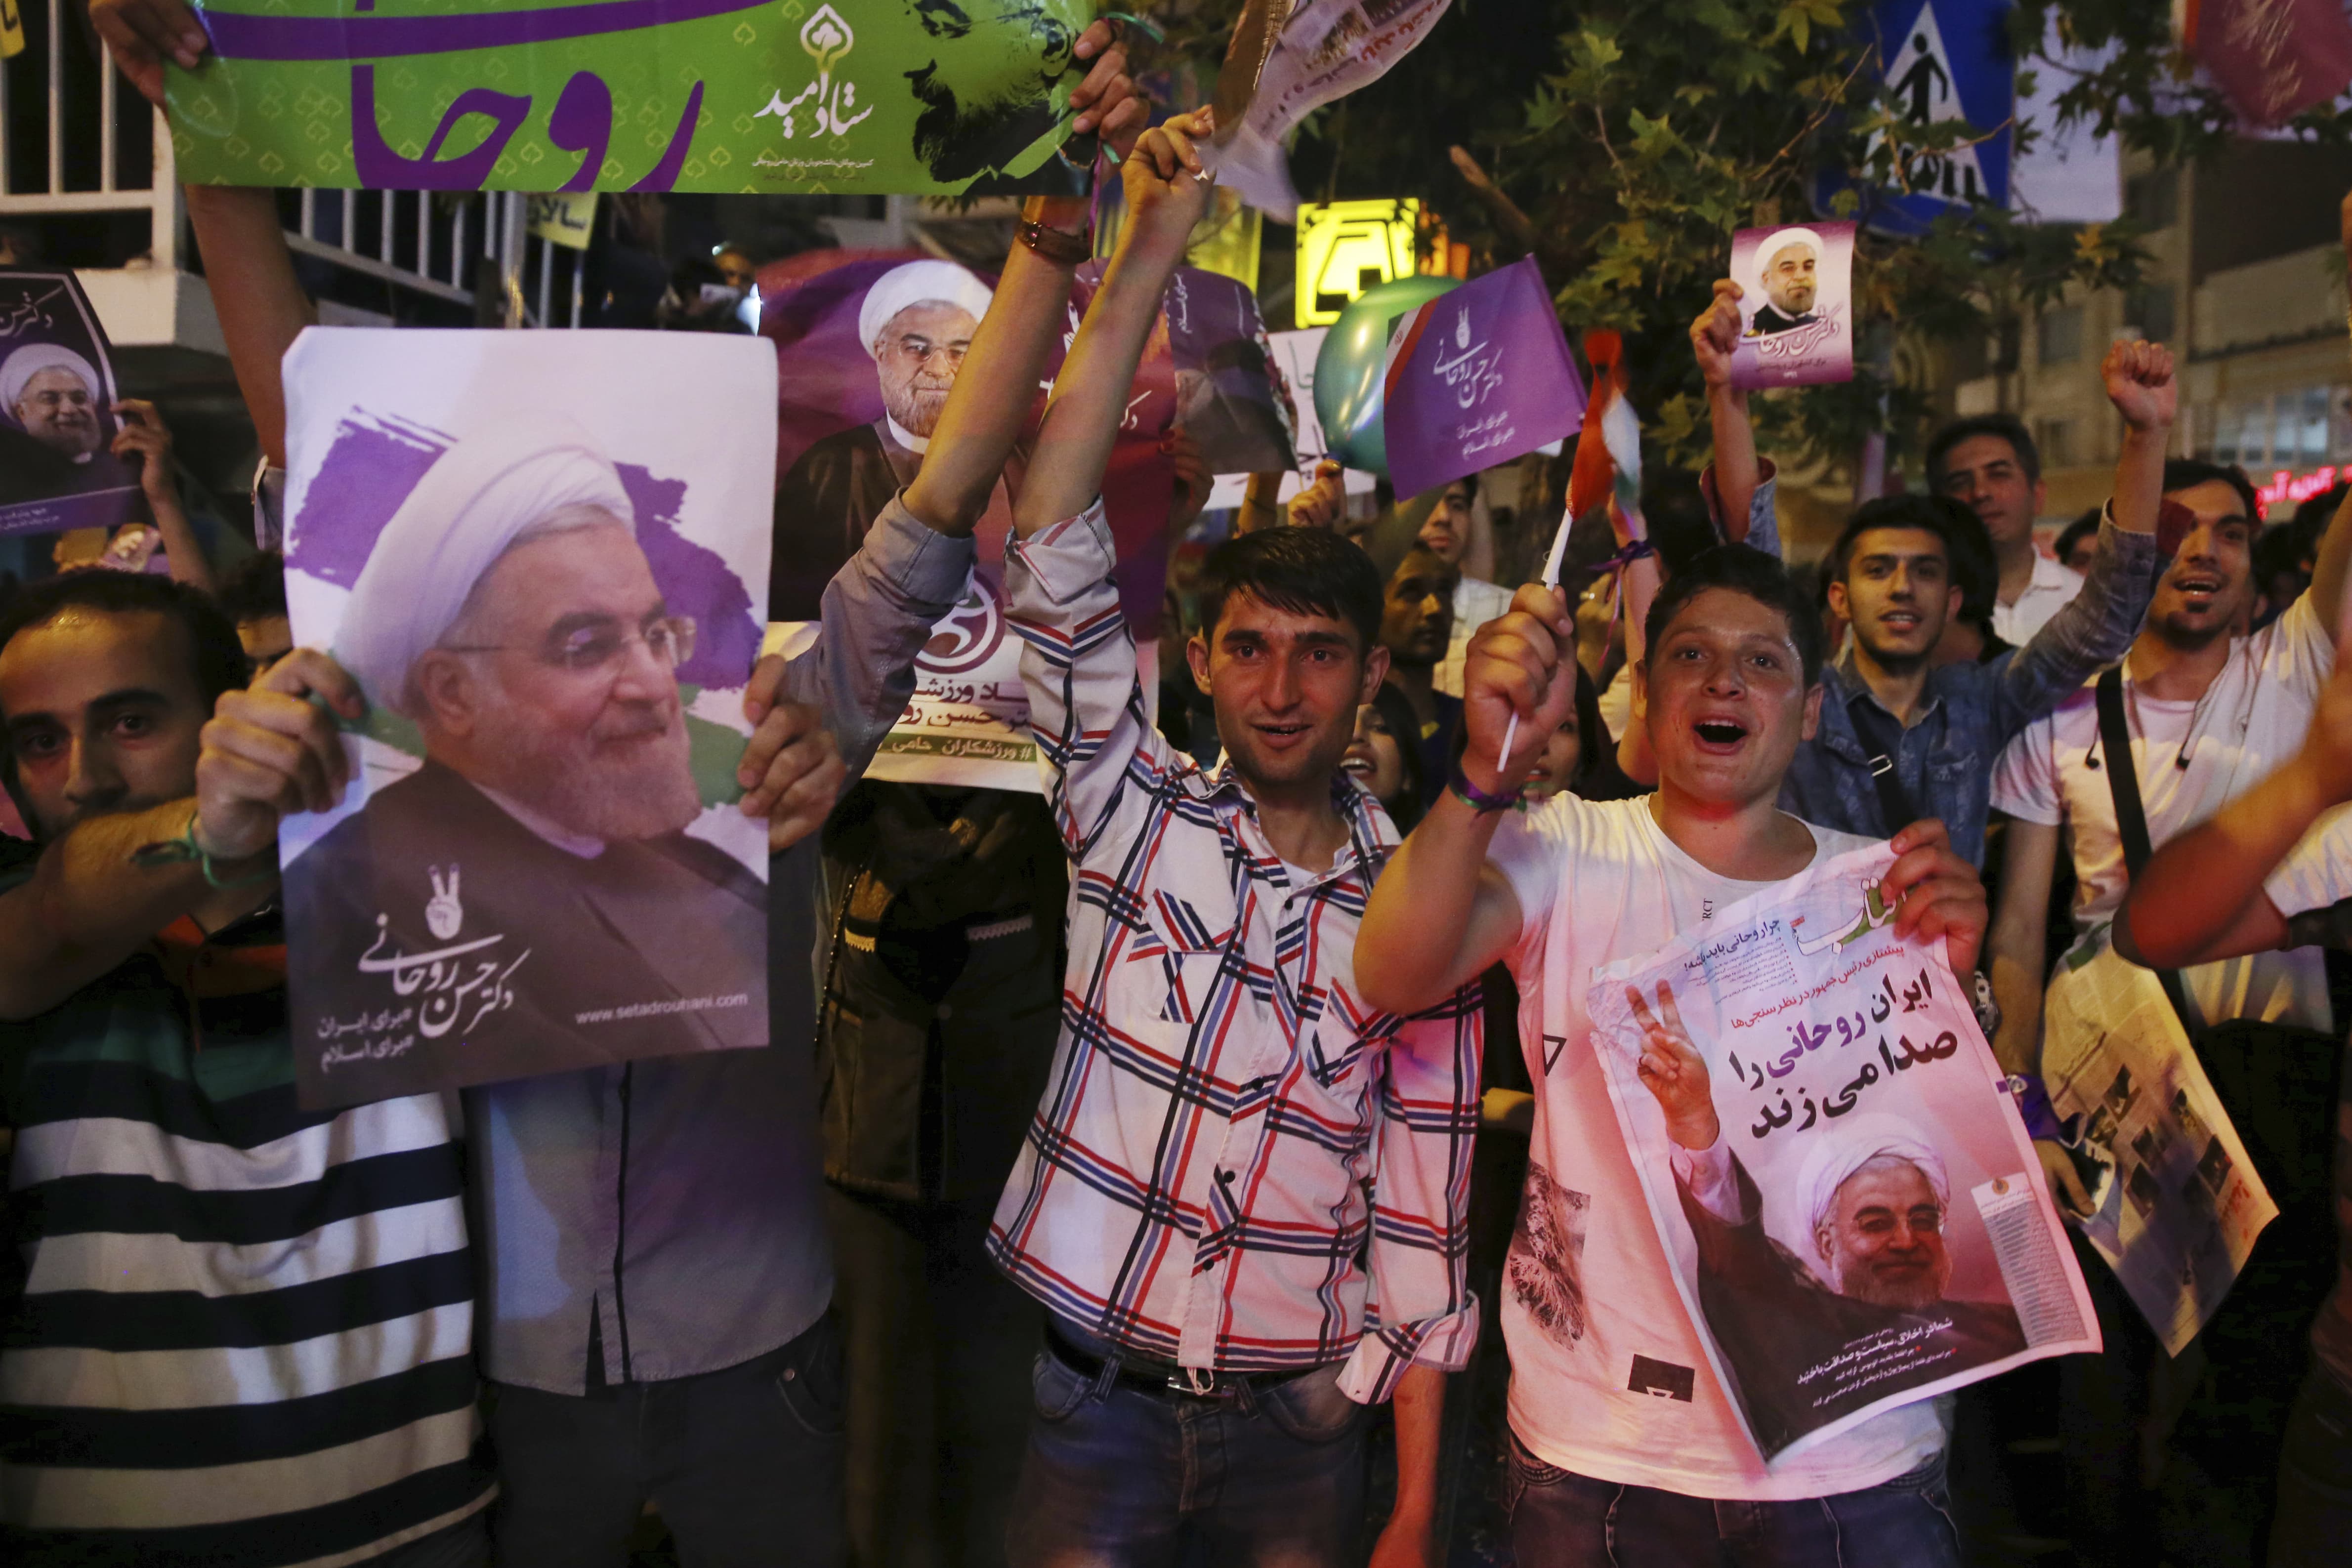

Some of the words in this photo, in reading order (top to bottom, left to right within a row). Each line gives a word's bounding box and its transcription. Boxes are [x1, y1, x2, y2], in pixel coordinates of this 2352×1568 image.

[808, 81, 874, 138] ستاد
[927, 711, 1002, 727] حسن
[1702, 898, 1713, 921] RCT
[1763, 919, 1780, 936] چرا
[358, 911, 504, 995] روحانی
[1706, 943, 1726, 959] باید
[1726, 929, 1765, 953] روحانی
[419, 961, 498, 1037] حسن
[462, 948, 532, 1035] دکتر
[576, 993, 748, 1025] www.setadrouhani.com
[1871, 967, 1932, 1024] ایران
[1766, 1011, 1866, 1078] روحانی
[1878, 1030, 1958, 1076] صدا
[1728, 1050, 1764, 1091] را
[1822, 1063, 1879, 1118] می
[1751, 1087, 1817, 1139] زند
